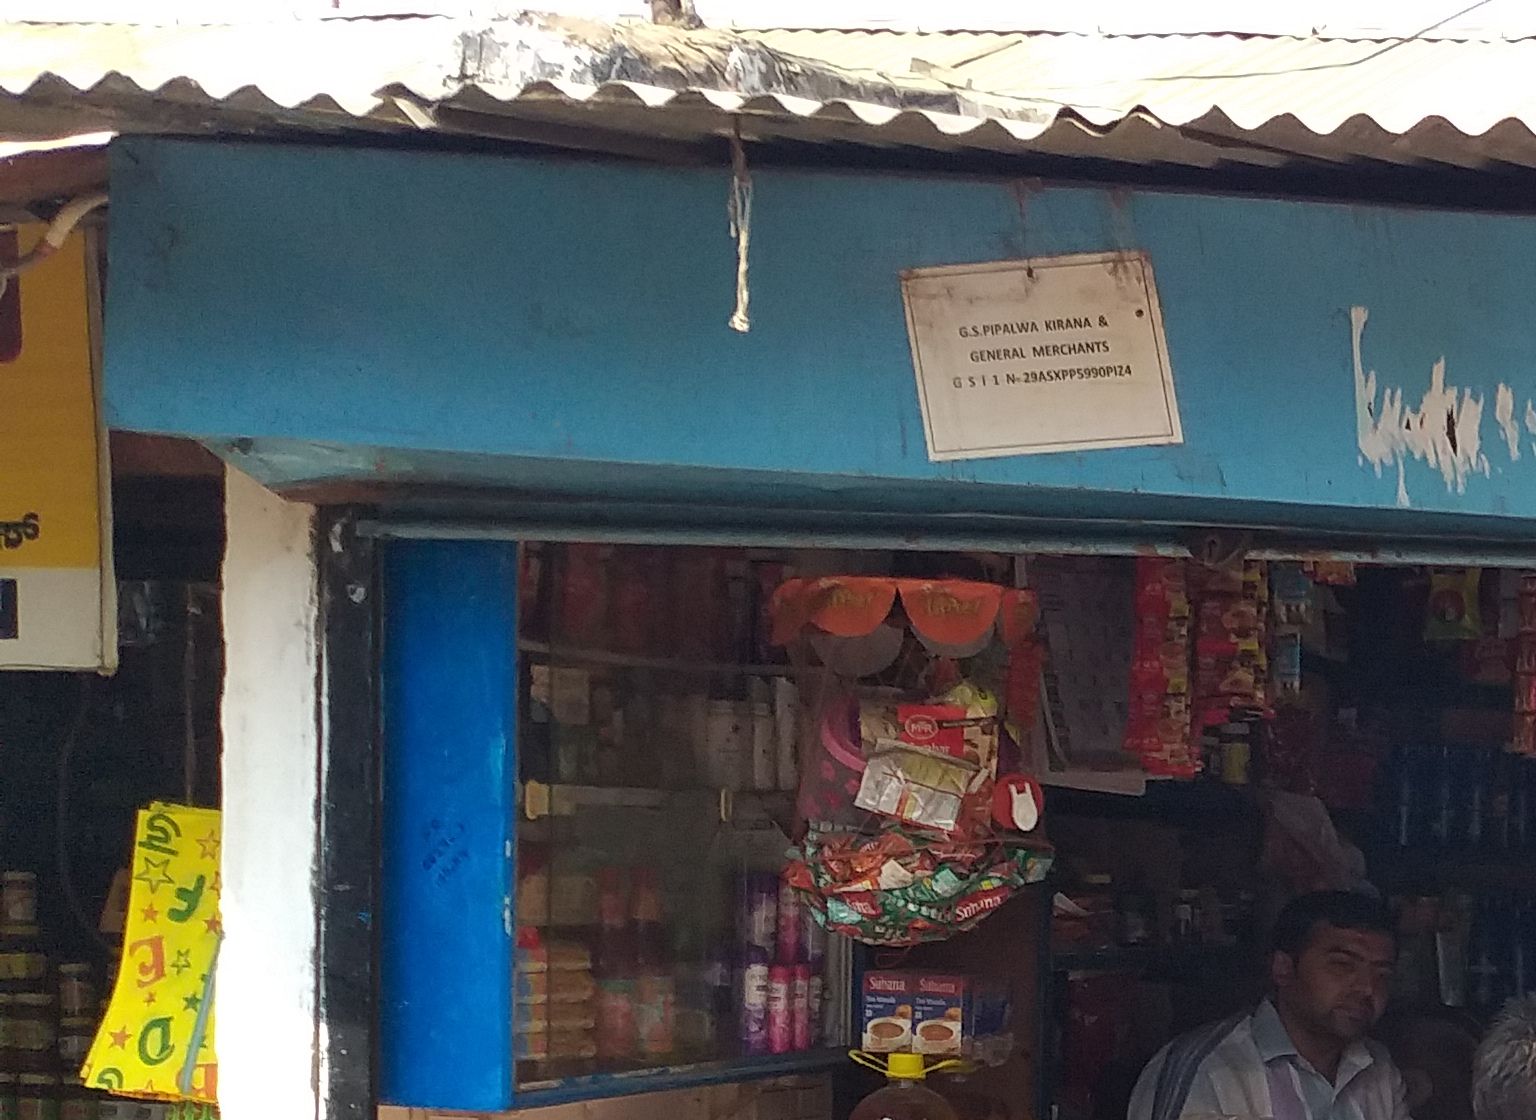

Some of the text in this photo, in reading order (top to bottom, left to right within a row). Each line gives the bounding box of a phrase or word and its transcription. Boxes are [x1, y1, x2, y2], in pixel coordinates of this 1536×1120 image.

[1045, 316, 1092, 333] KIRANA
[1097, 315, 1109, 328] &
[970, 340, 1110, 363] GENERAL MERCHANTS
